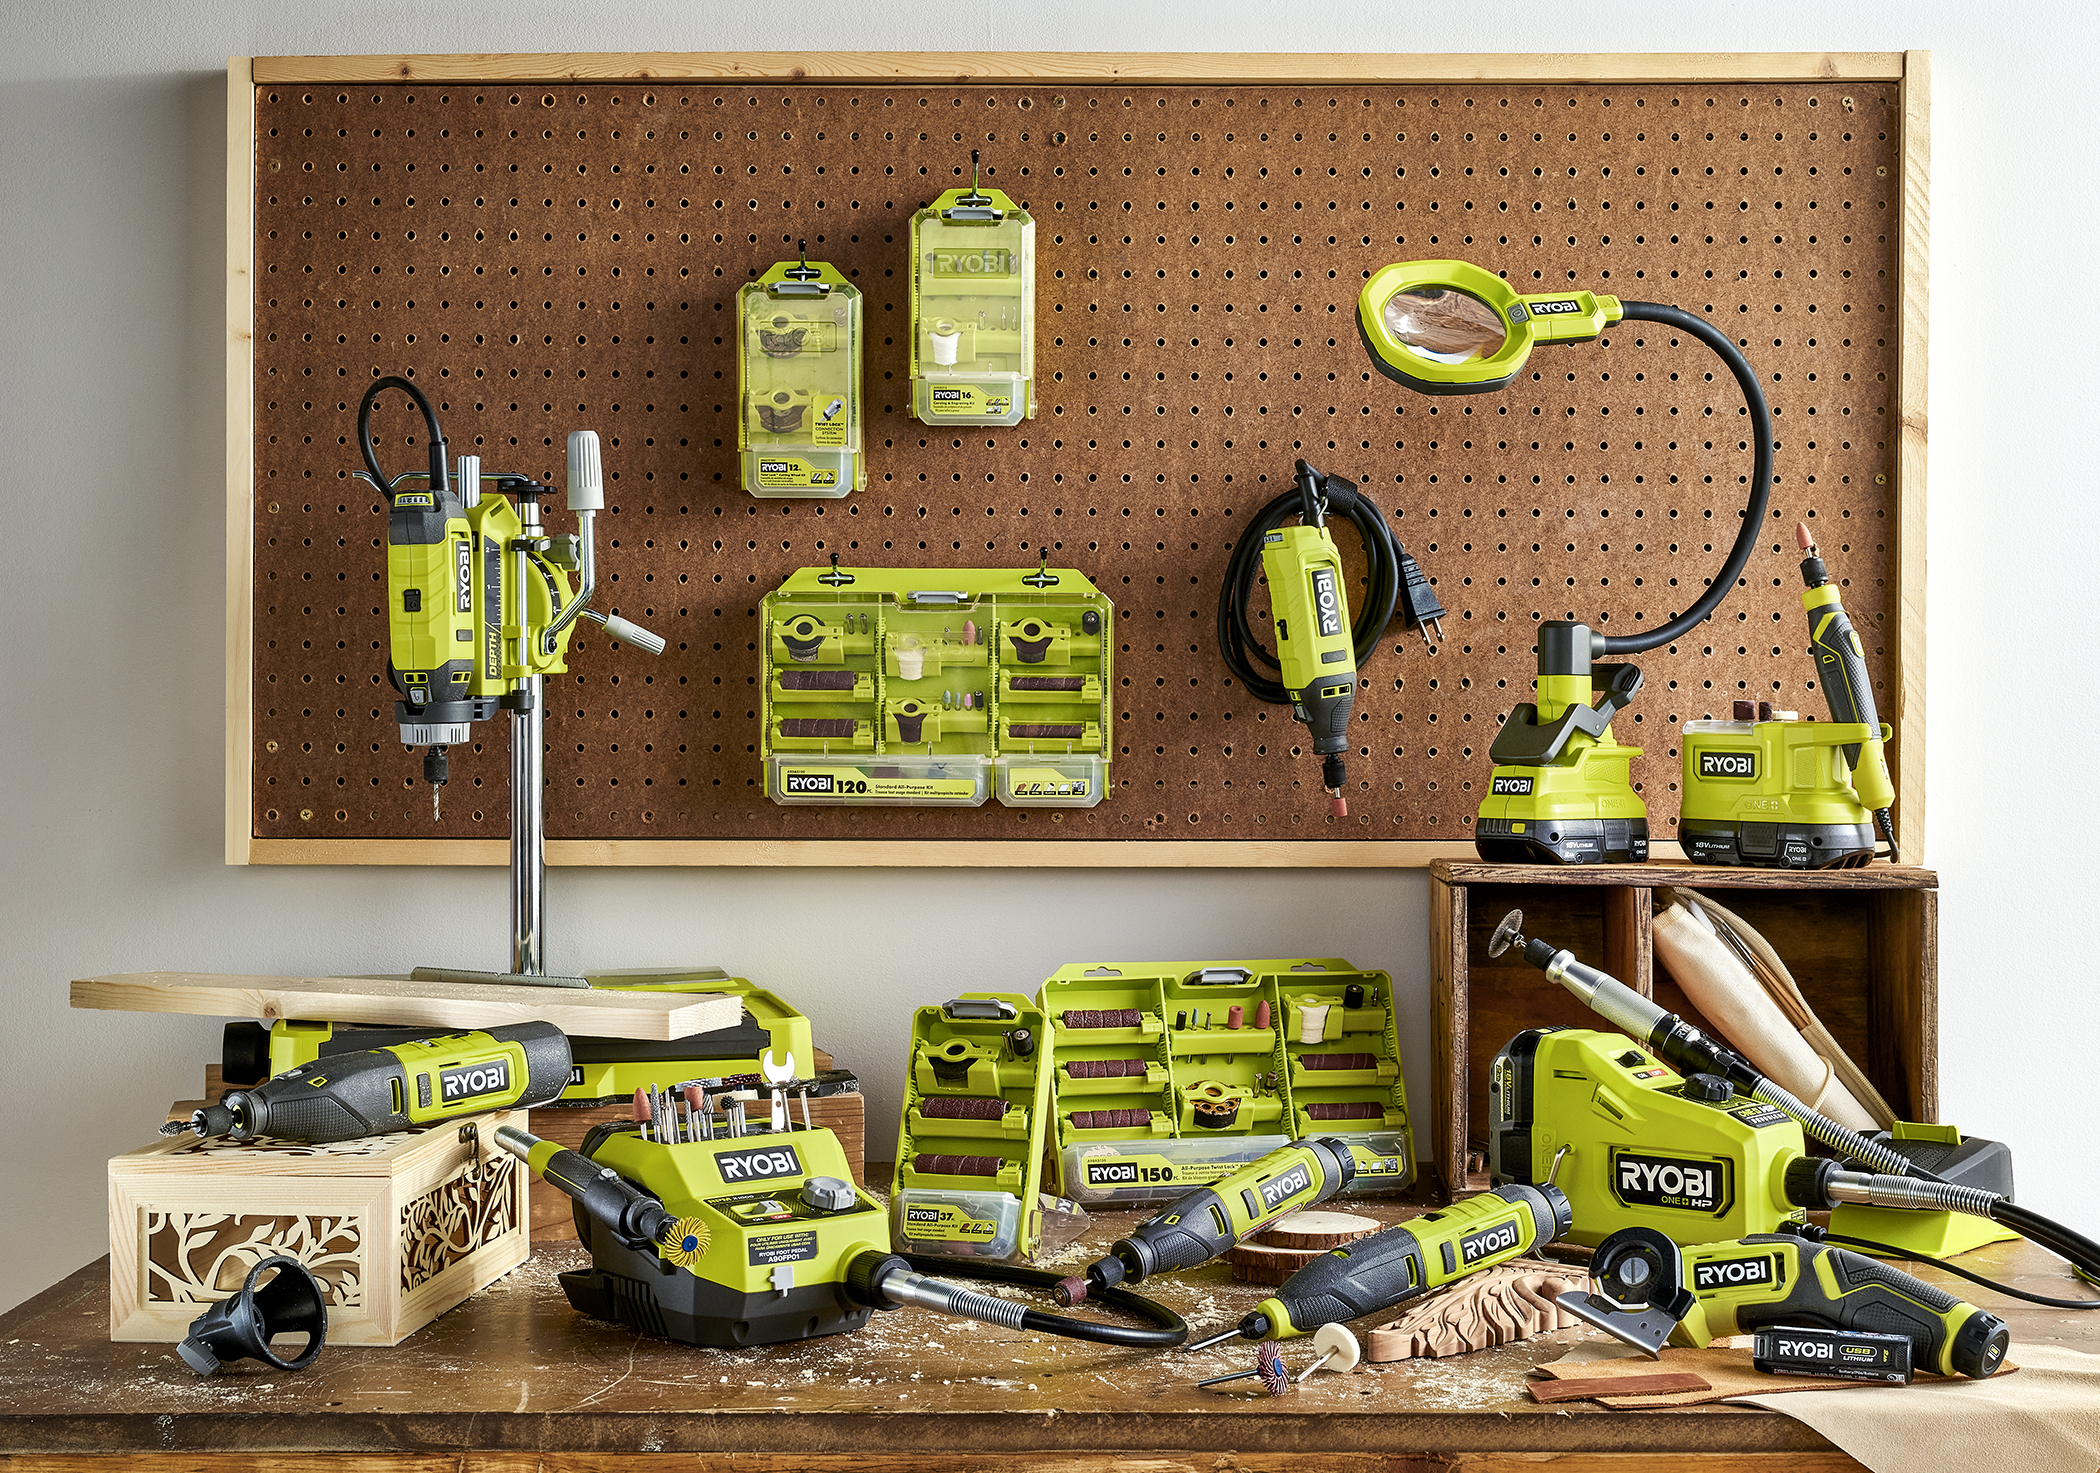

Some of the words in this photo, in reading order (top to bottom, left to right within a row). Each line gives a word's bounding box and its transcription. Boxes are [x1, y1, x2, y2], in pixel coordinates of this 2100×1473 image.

[937, 254, 1005, 273] RYOBI
[1532, 301, 1578, 314] RYOBI
[762, 326, 831, 347] RYOBI
[935, 391, 959, 399] RYOBI
[761, 463, 786, 472] RYOBI
[460, 546, 470, 609] RYOBI
[1316, 573, 1338, 633] RYOBI
[489, 632, 497, 676] DEPTH
[1703, 756, 1751, 773] RYOBI
[789, 777, 831, 790] RYOBI
[837, 780, 867, 794] 120
[1495, 779, 1531, 792] RYOBI
[443, 1067, 505, 1097] RYOBI
[719, 1151, 797, 1179] RYOBI
[1090, 1165, 1135, 1181] RYOBI
[1141, 1167, 1173, 1182] 150
[1262, 1169, 1308, 1205] RYOBI
[1620, 1161, 1713, 1198] RYOBI
[1691, 1198, 1713, 1207] HP
[909, 1211, 937, 1220] RYOBI
[940, 1213, 953, 1221] 37
[1463, 1226, 1517, 1261] RYOBI
[768, 1254, 800, 1263] A90FP01
[1697, 1260, 1766, 1285] RYOBI
[1778, 1340, 1834, 1359] RYOBI
